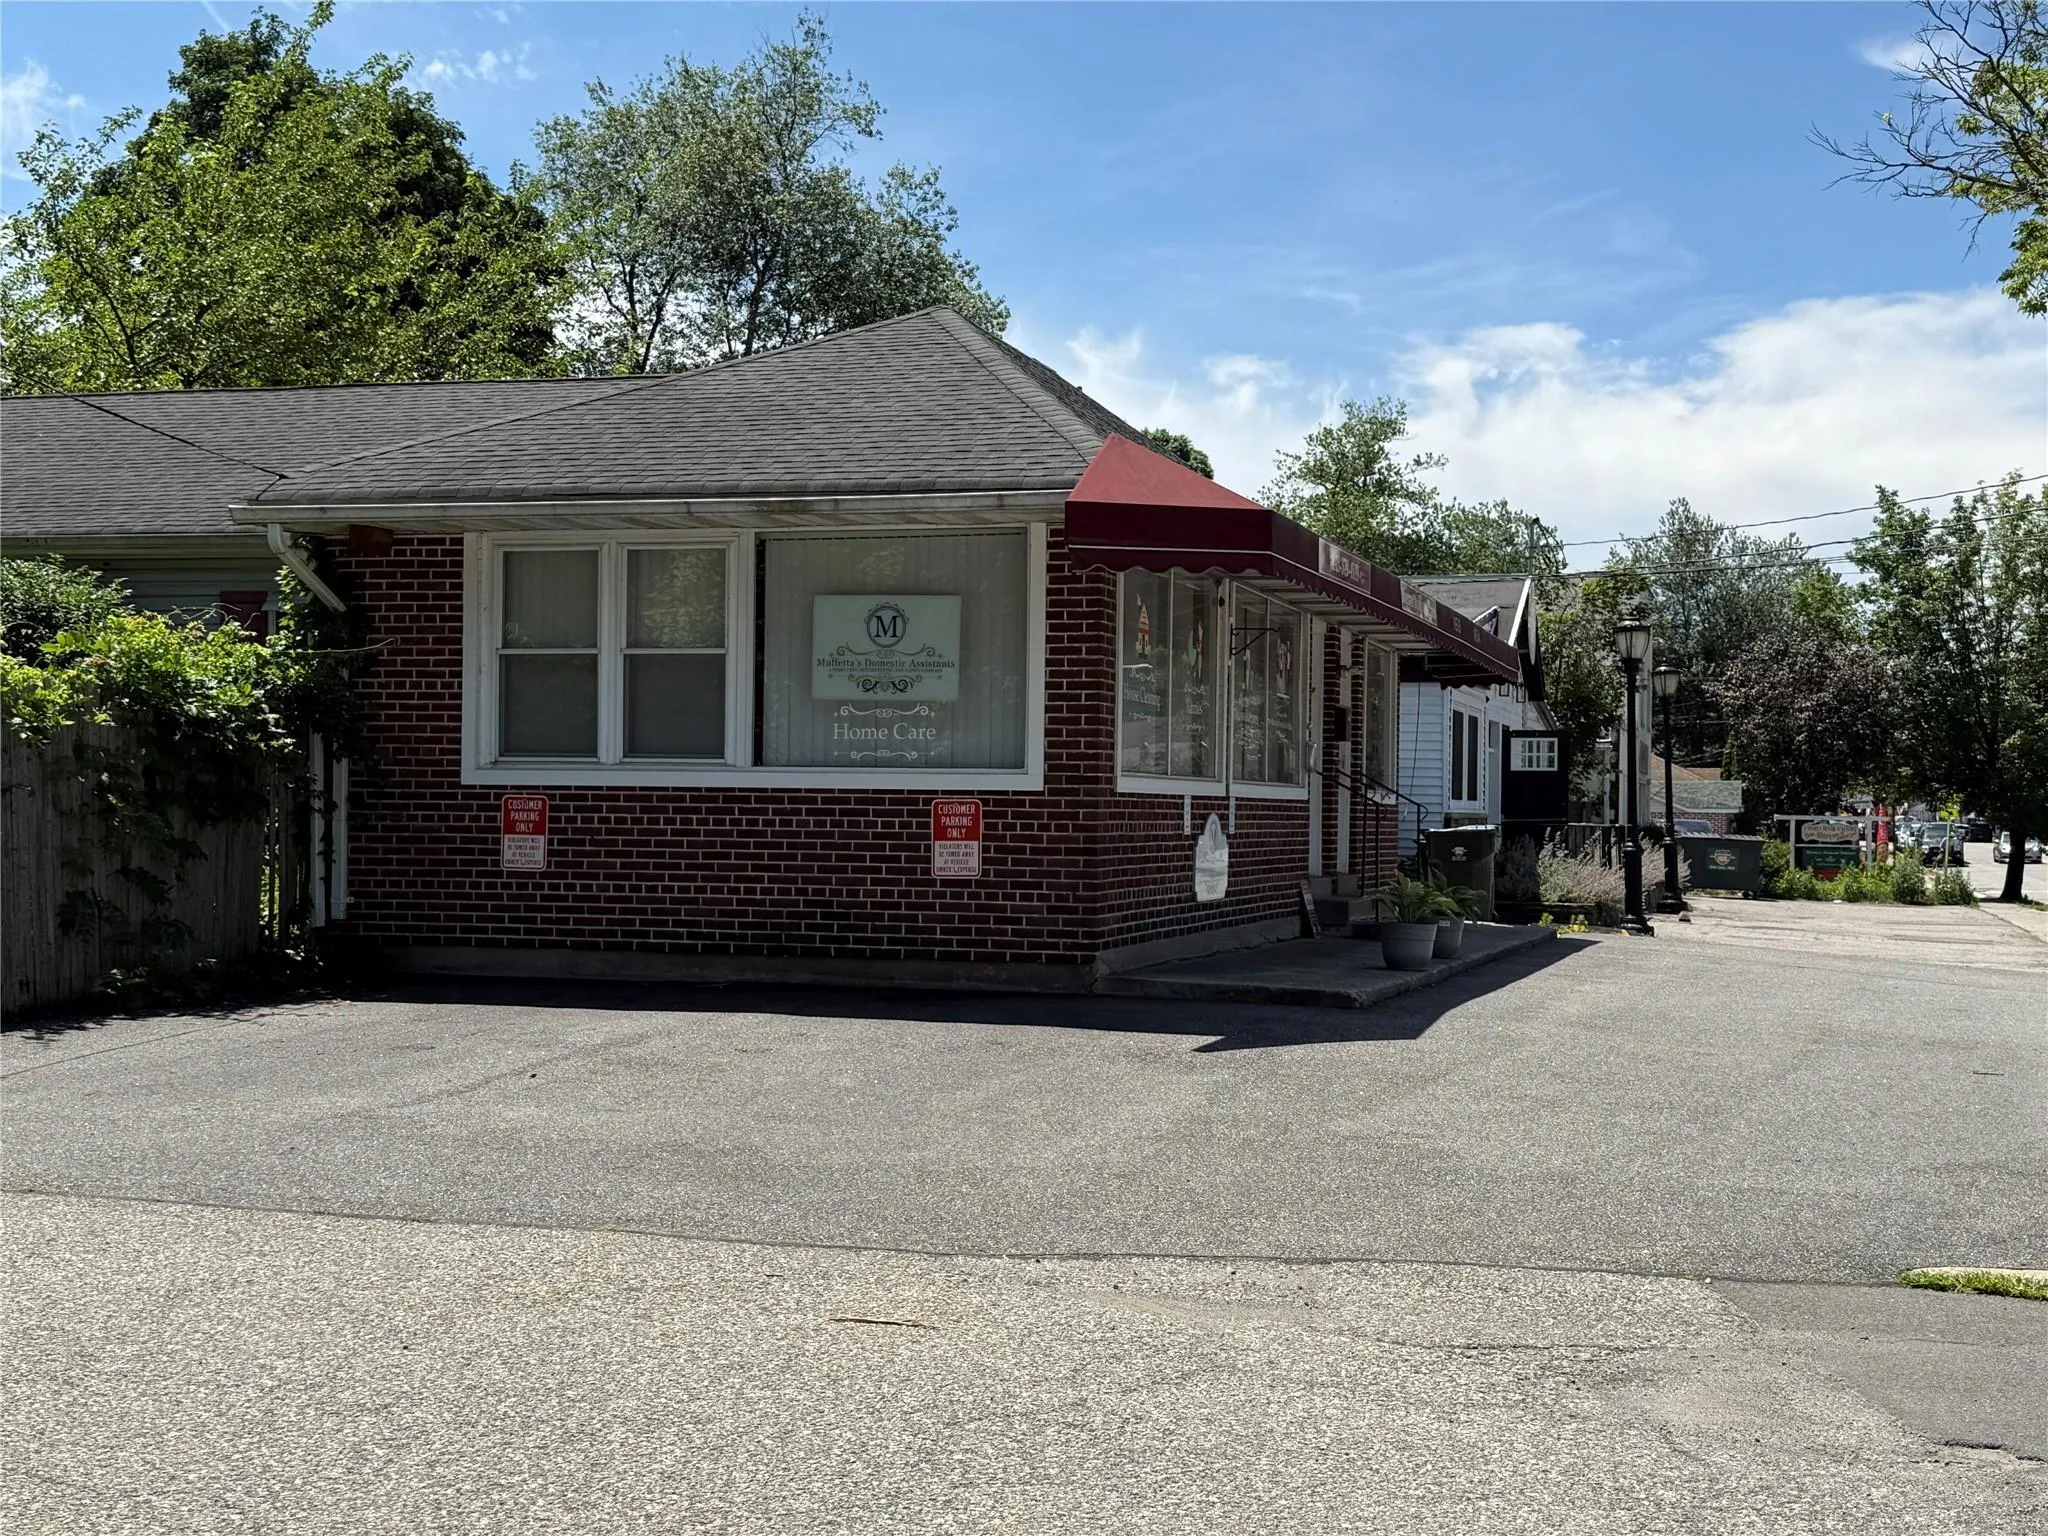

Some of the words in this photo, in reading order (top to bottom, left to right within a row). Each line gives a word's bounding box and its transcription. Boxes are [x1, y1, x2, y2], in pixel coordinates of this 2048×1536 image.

[874, 615, 899, 638] M
[816, 658, 862, 668] Muffetta's
[865, 658, 906, 668] Domestic
[910, 659, 956, 669] Assistants
[833, 723, 888, 740] Home
[893, 722, 936, 740] Care
[508, 799, 543, 810] CUSTOMER
[938, 803, 976, 815] CUSTOMER
[510, 811, 540, 821] PARKING
[941, 816, 973, 826] PARKING
[515, 822, 534, 833] ONLY
[947, 828, 967, 838] ONLY
